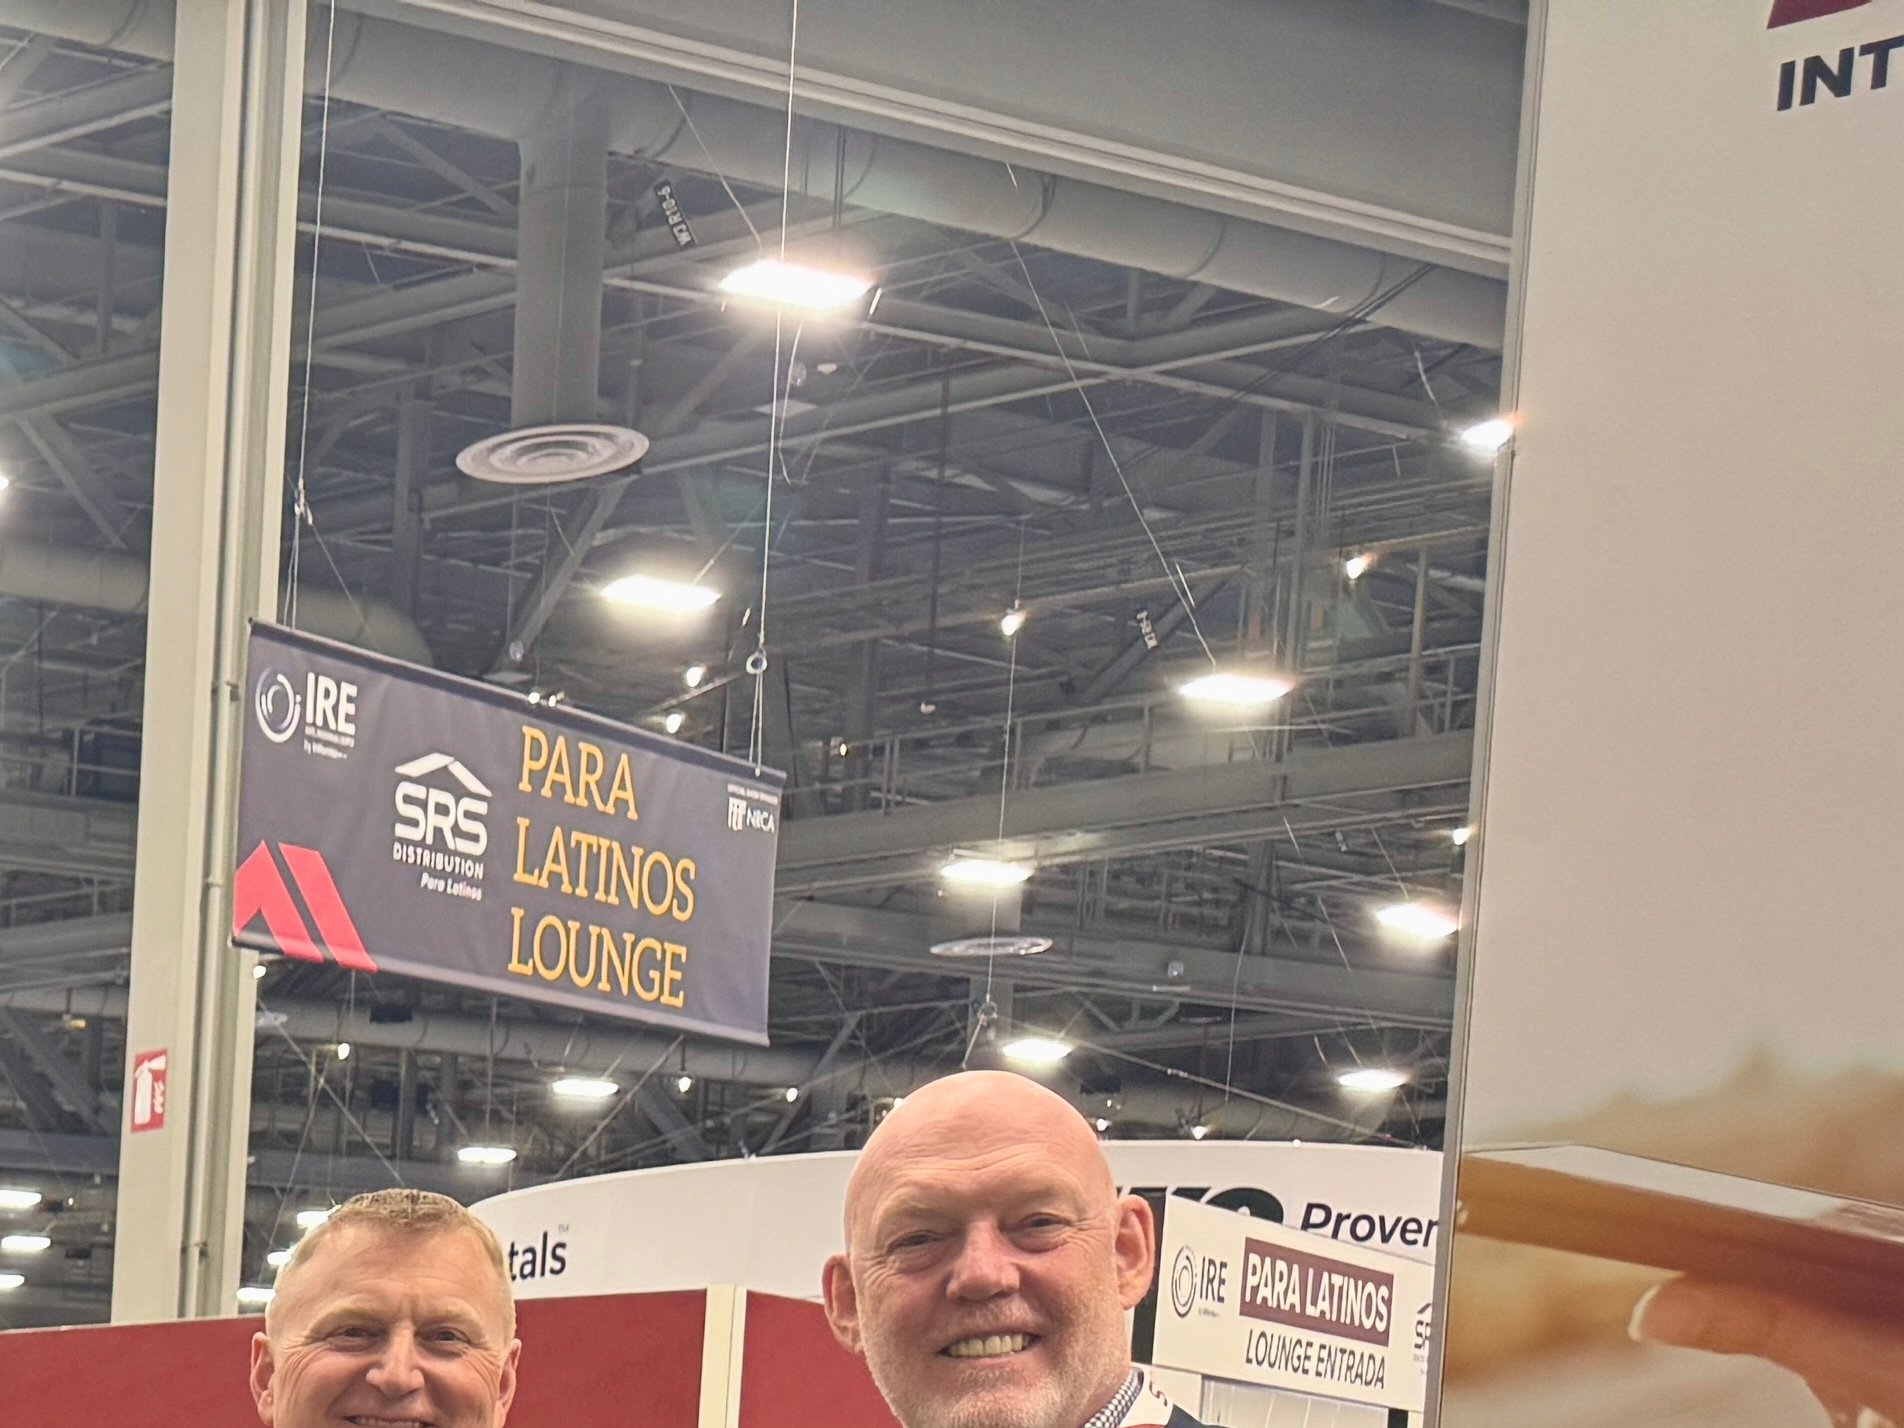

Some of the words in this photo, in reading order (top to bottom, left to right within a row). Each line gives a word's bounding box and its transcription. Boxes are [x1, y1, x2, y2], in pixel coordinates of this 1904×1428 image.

[1777, 35, 1904, 111] INT
[305, 672, 357, 735] IRE
[520, 725, 638, 820] PARA
[395, 781, 488, 856] SRS
[393, 842, 484, 880] DISTRIBUTION
[421, 872, 445, 892] Para
[514, 817, 695, 922] LATINOS
[508, 907, 686, 1008] LOUNGE
[1201, 1256, 1226, 1303] IRE
[1245, 1253, 1299, 1314] PARA
[1306, 1268, 1390, 1332] LATINOS
[1245, 1329, 1312, 1375] LOUNGE
[1315, 1344, 1385, 1389] ENTRADA
